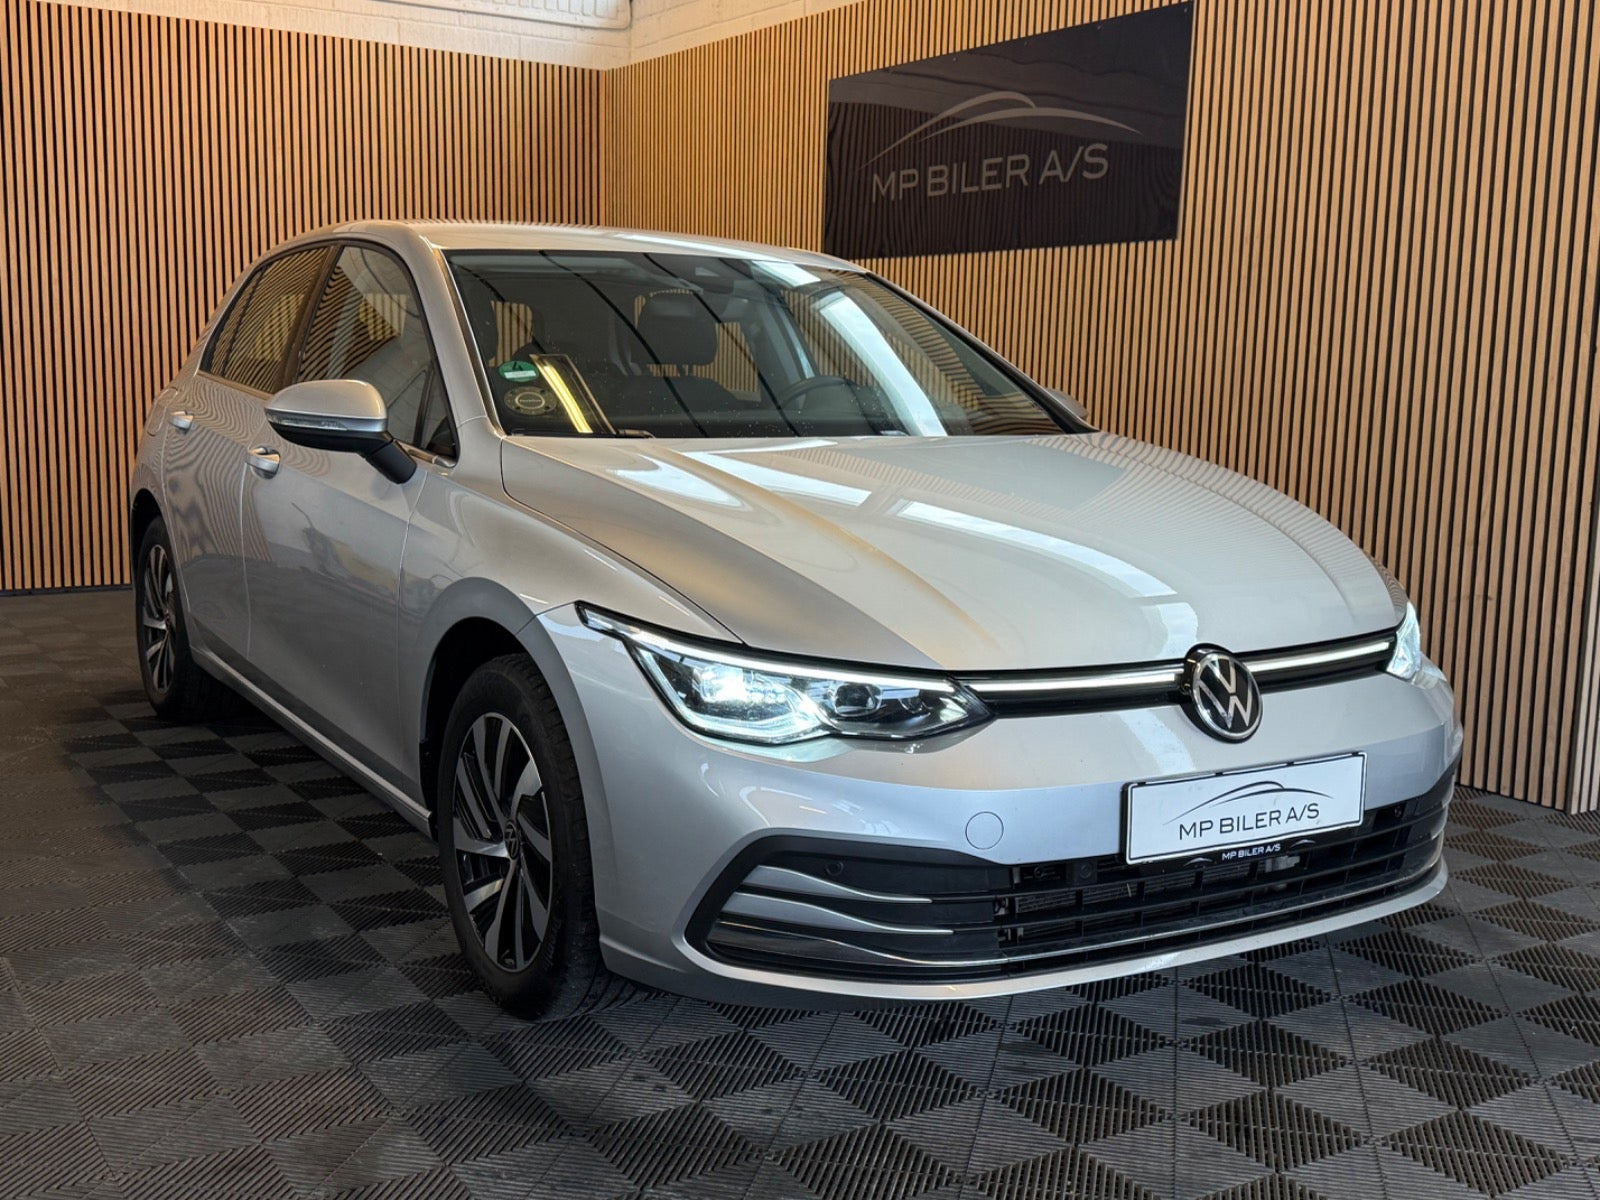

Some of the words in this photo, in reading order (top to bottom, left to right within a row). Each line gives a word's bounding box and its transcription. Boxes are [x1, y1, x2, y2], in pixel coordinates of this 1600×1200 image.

[872, 168, 920, 203] MP
[927, 153, 1030, 197] BILER
[1038, 142, 1109, 185] A/S
[1179, 819, 1214, 841] MP
[1219, 809, 1281, 835] BILER
[1285, 802, 1320, 823] A/S
[1221, 850, 1237, 861] MP
[1238, 846, 1265, 858] BILER
[1265, 843, 1281, 854] A/S
